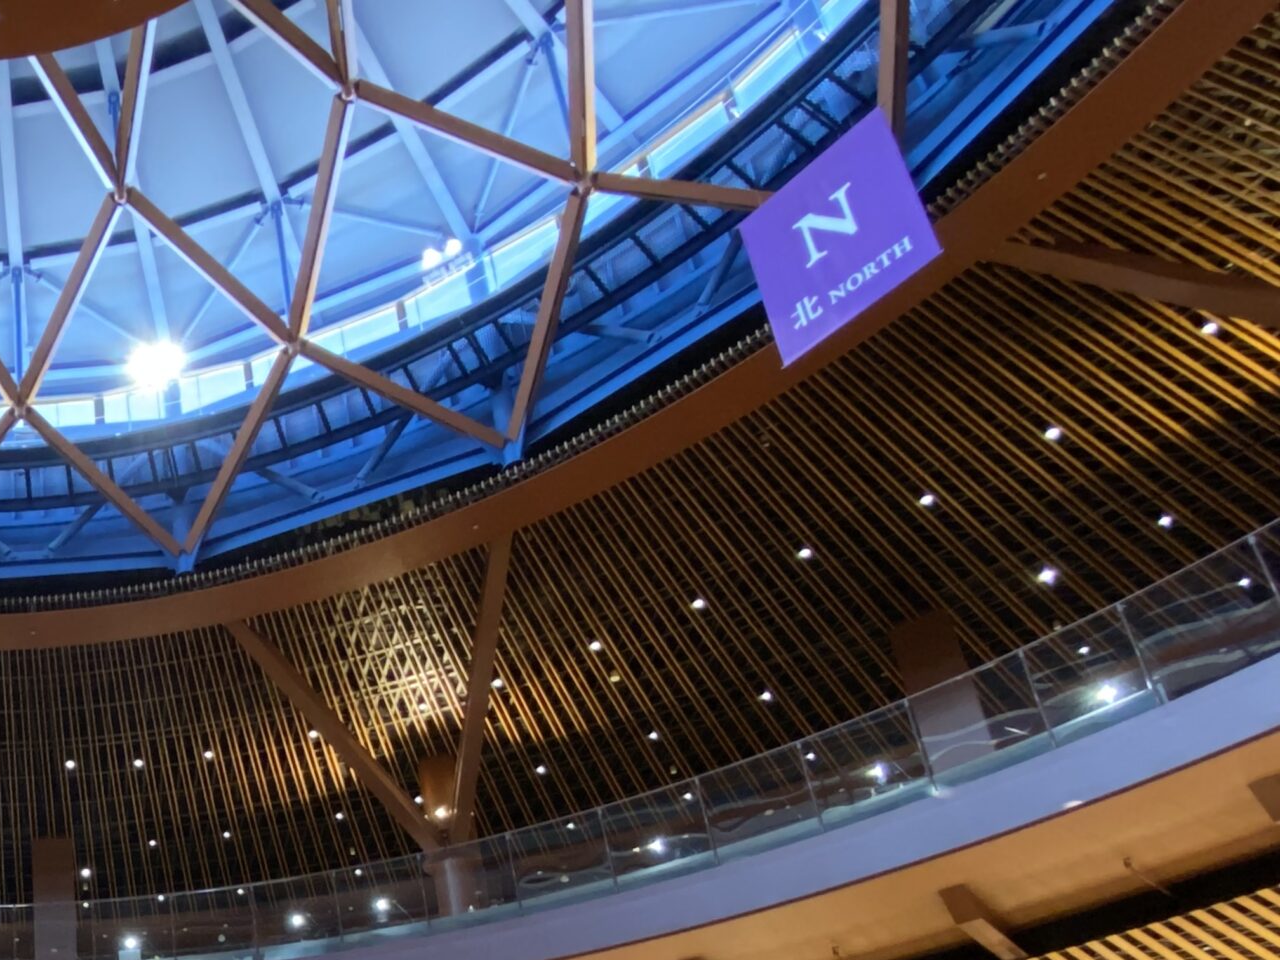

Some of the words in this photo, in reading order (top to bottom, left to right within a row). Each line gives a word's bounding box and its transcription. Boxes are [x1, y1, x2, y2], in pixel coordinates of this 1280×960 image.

[792, 181, 858, 269] N
[790, 293, 823, 331] 北
[828, 235, 914, 307] NORTH
